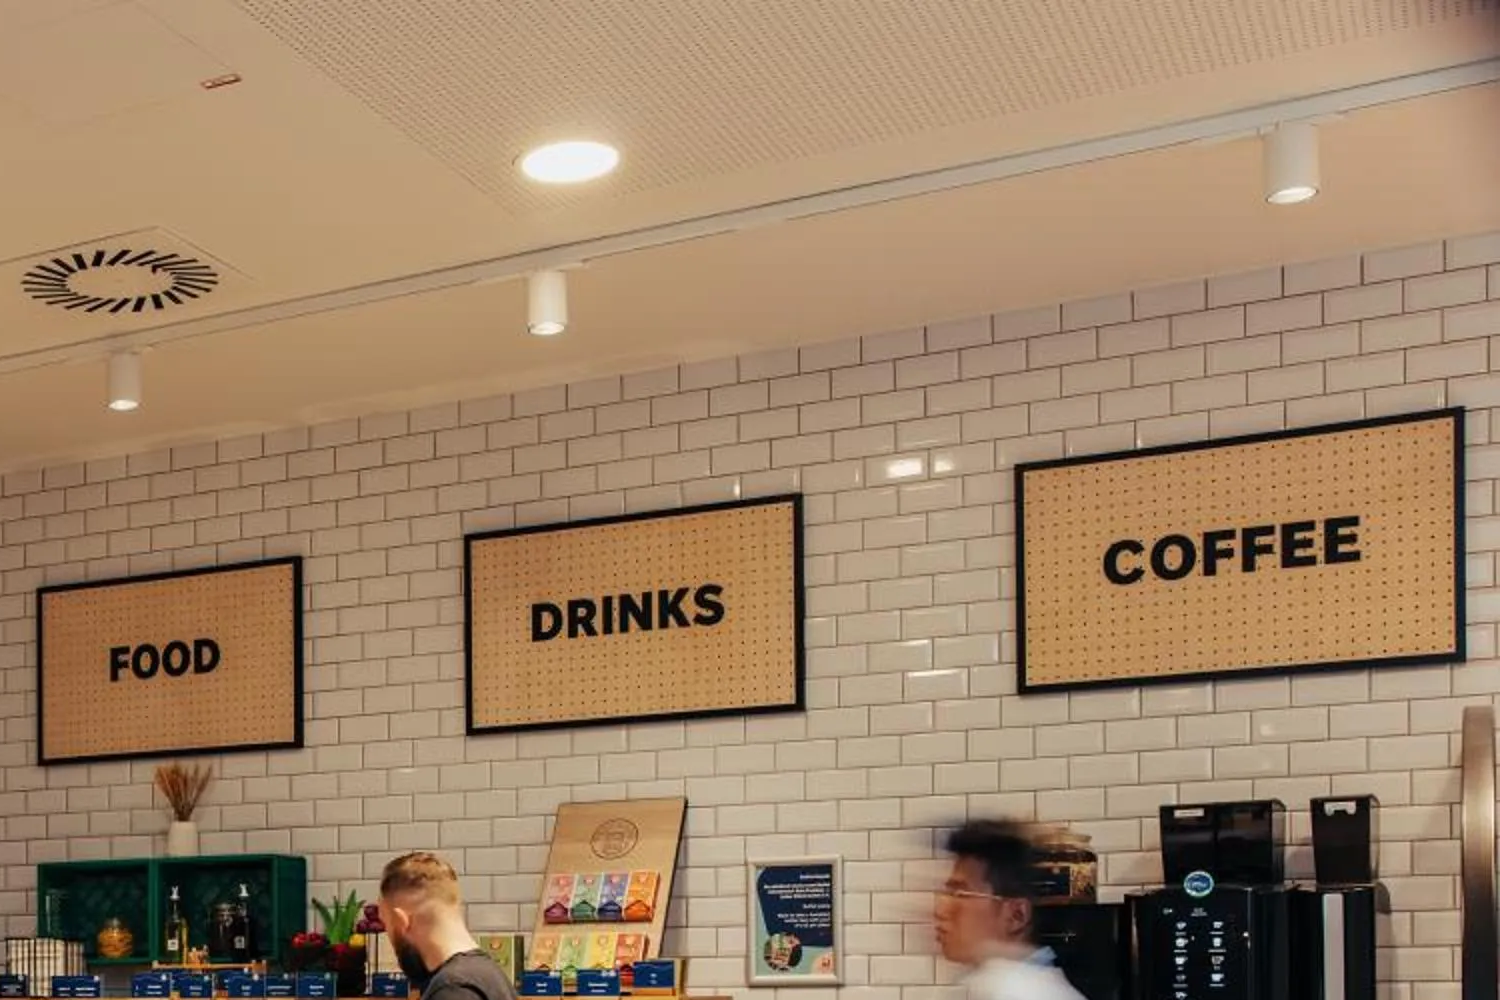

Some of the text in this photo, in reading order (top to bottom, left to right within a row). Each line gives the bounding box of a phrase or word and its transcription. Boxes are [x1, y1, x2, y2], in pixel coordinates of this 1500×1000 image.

[1103, 515, 1361, 586] COFFEE
[531, 583, 725, 643] DRINKS
[109, 637, 221, 683] FOOD
